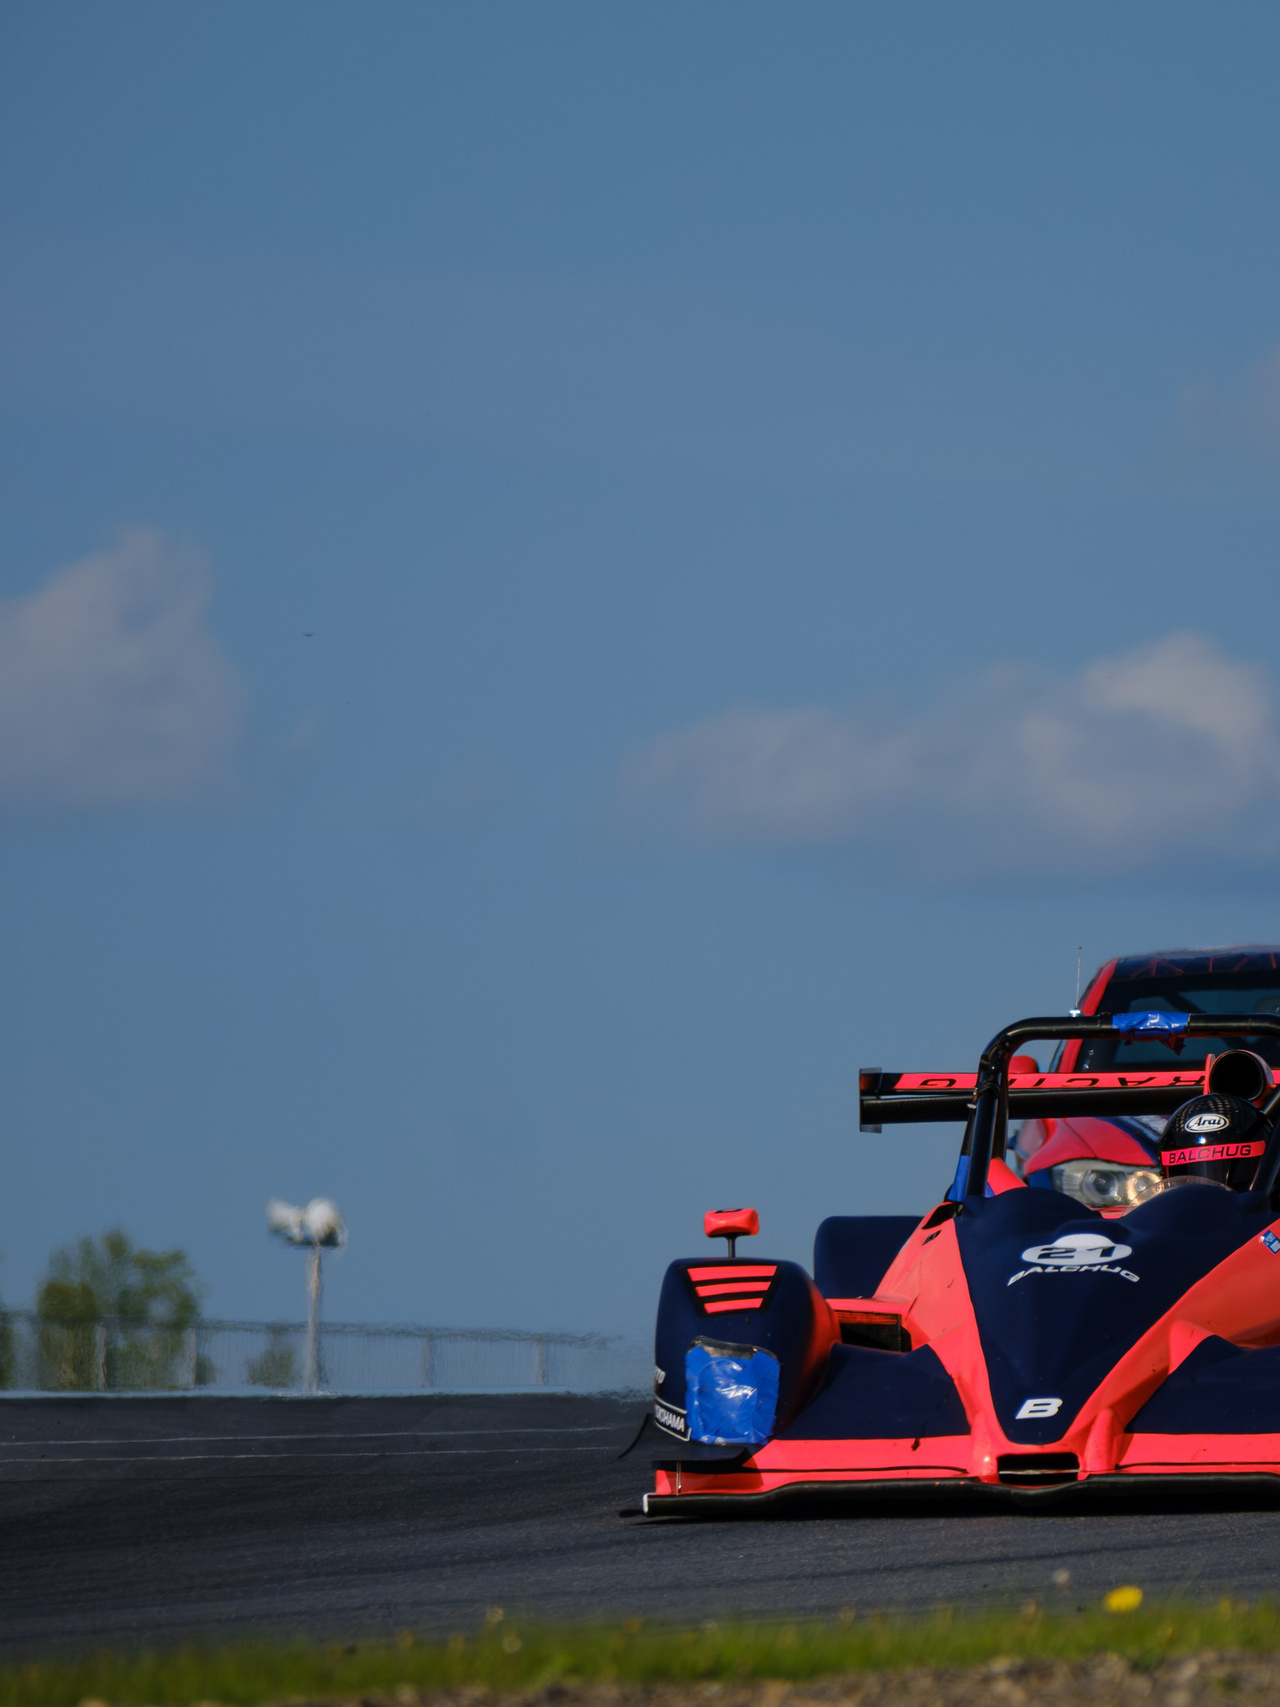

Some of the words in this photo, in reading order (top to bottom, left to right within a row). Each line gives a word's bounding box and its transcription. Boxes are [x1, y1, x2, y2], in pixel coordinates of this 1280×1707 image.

[918, 1075, 1206, 1088] RACIG
[1191, 1116, 1222, 1128] Arai
[1169, 1144, 1252, 1164] BALCHUG
[1037, 1246, 1117, 1260] 21
[1007, 1264, 1141, 1287] BALCHUG
[1015, 1398, 1063, 1419] B
